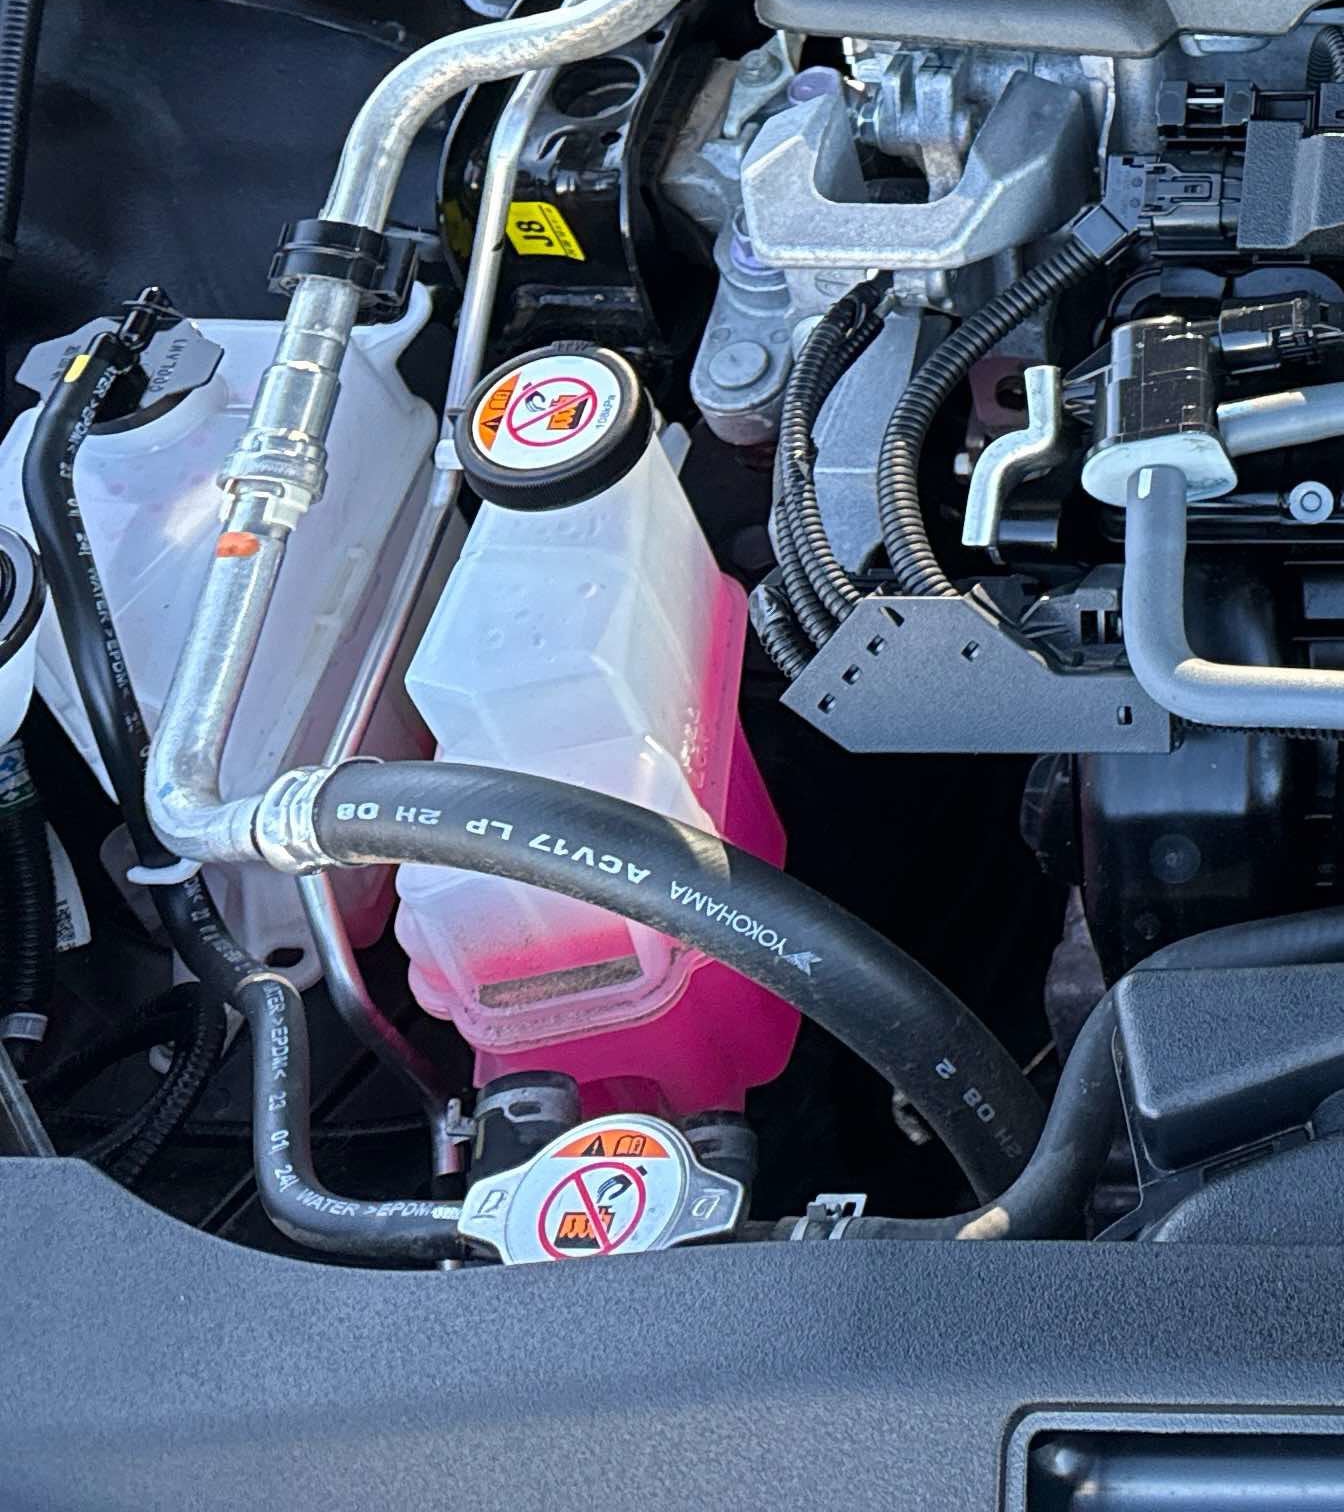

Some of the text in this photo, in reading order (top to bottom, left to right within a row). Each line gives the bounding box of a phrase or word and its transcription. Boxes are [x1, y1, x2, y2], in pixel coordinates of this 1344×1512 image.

[515, 220, 554, 248] J8
[395, 806, 442, 826] 2H
[465, 818, 514, 841] LP
[528, 833, 651, 885] ACV17
[669, 880, 788, 955] YOKOHAMA
[935, 1057, 957, 1079] 2
[268, 1091, 288, 1112] 23
[963, 1087, 996, 1123] 08
[296, 1188, 356, 1217] WATER
